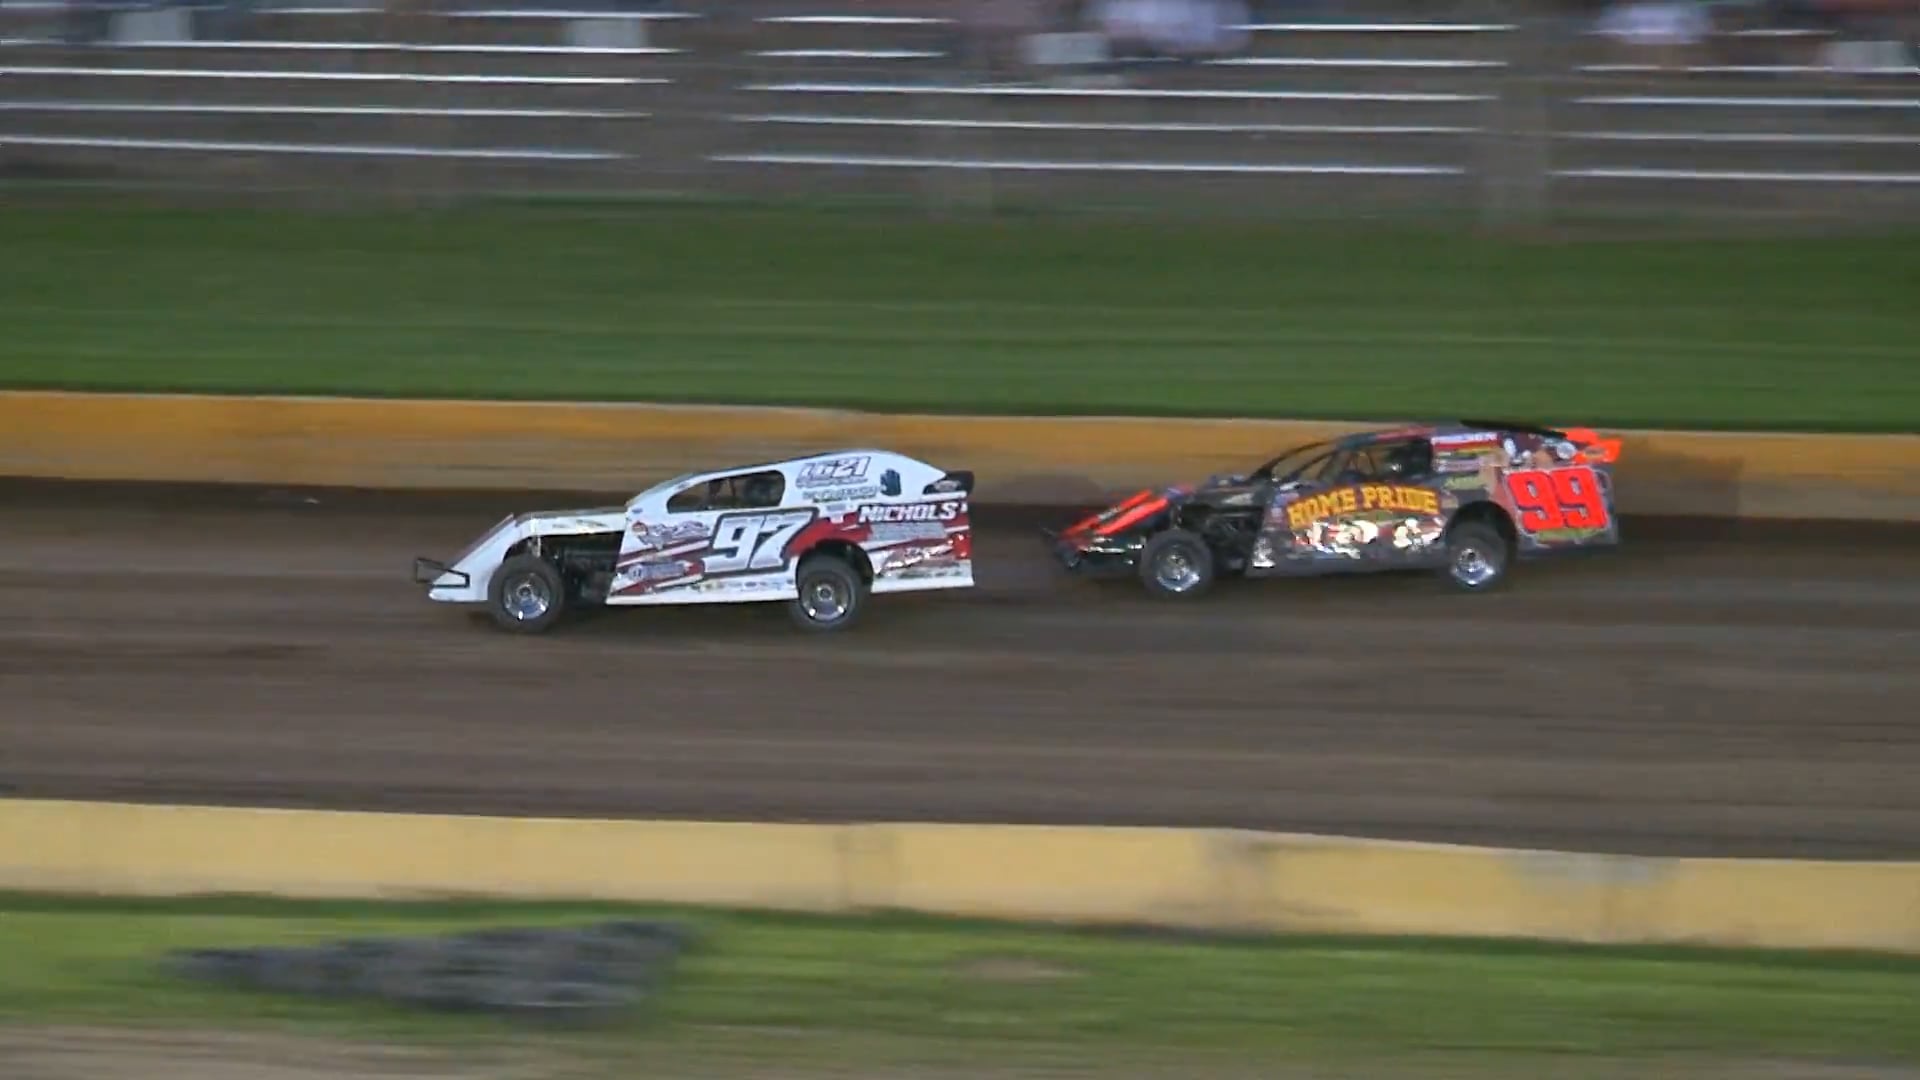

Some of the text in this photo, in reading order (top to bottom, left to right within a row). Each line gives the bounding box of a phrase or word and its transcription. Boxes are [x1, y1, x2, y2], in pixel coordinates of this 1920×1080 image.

[858, 502, 958, 522] NICHOLS
[1287, 482, 1441, 530] HOME PRIDE
[1507, 466, 1608, 533] 99
[702, 510, 817, 574] 97
